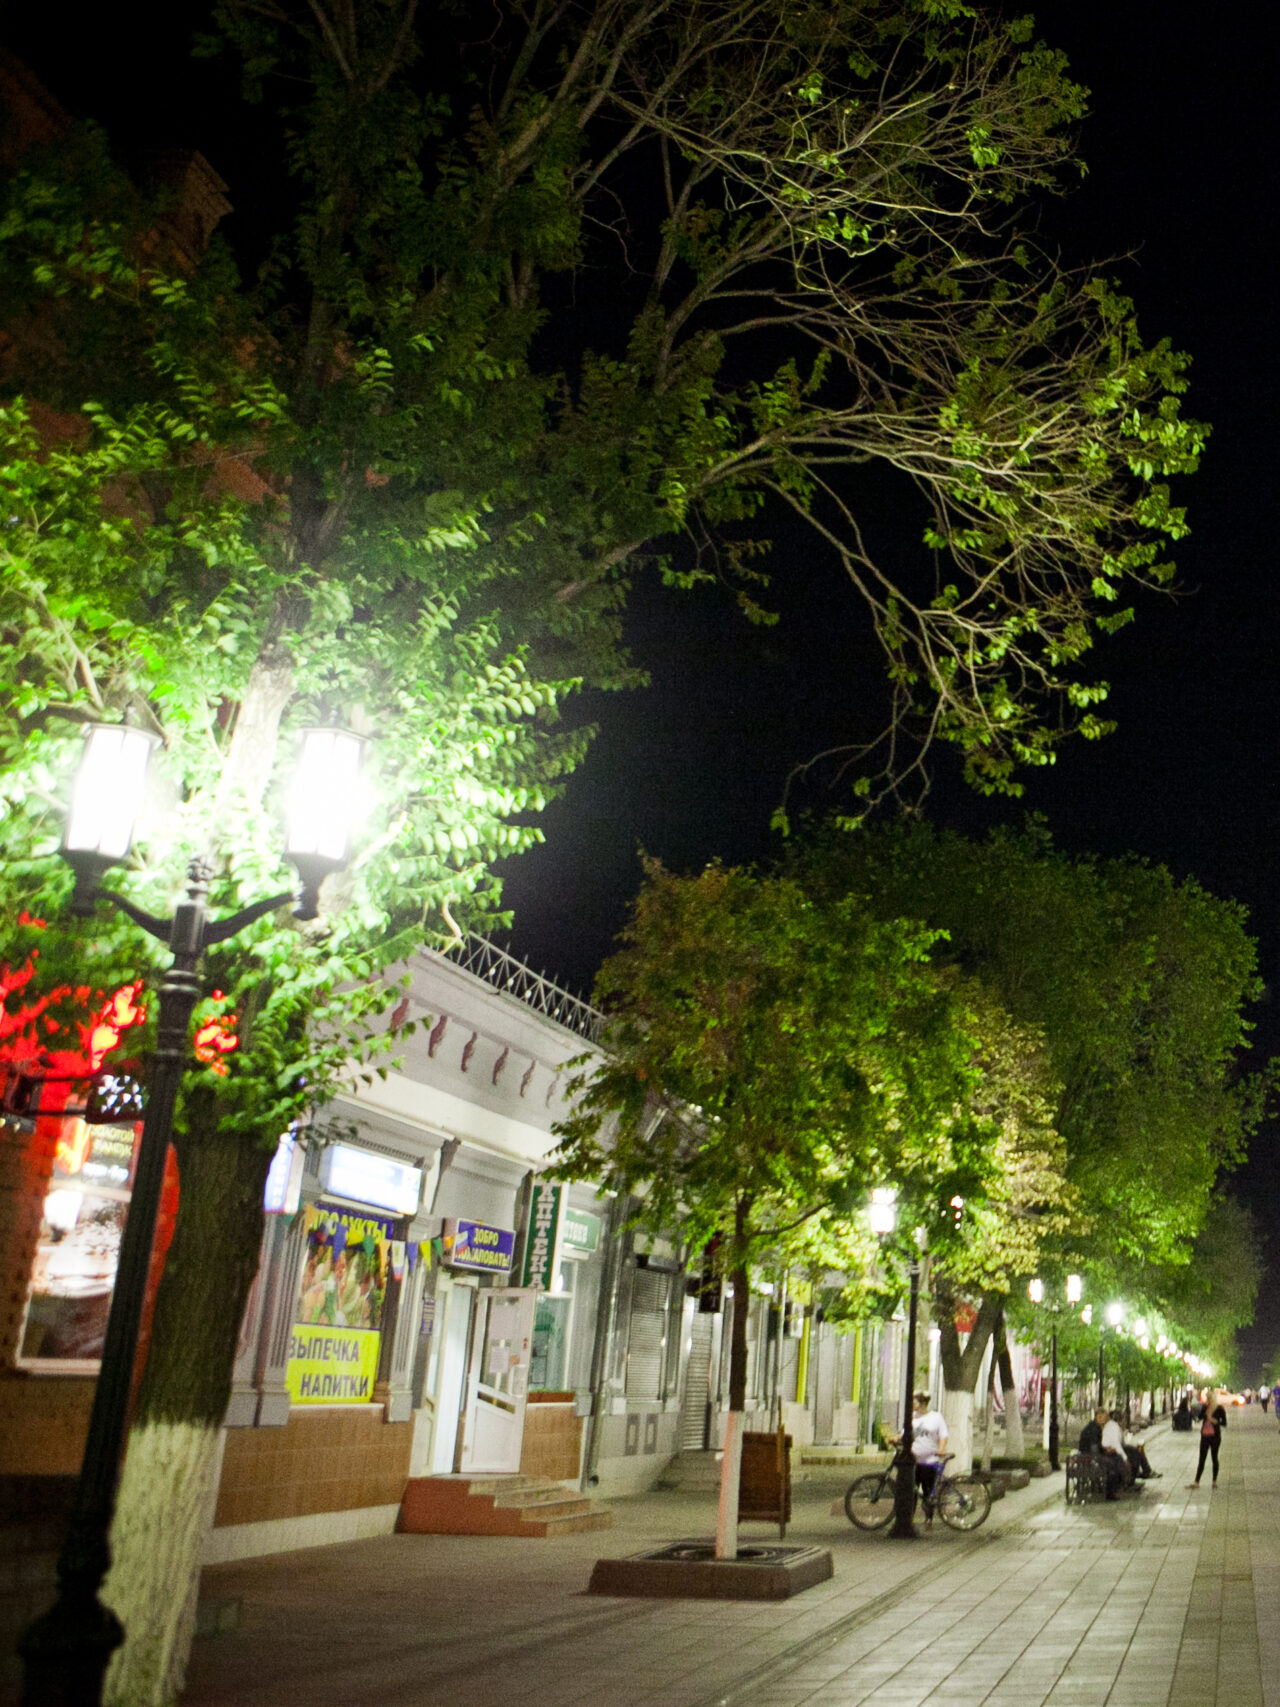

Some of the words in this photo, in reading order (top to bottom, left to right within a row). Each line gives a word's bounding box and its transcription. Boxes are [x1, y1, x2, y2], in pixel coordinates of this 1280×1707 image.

[473, 1228, 499, 1246] ДОБРО
[527, 1184, 556, 1290] АПТЕКА
[288, 1336, 359, 1362] ВЫПЕЧКА
[300, 1372, 369, 1397] НАПИТКИ
